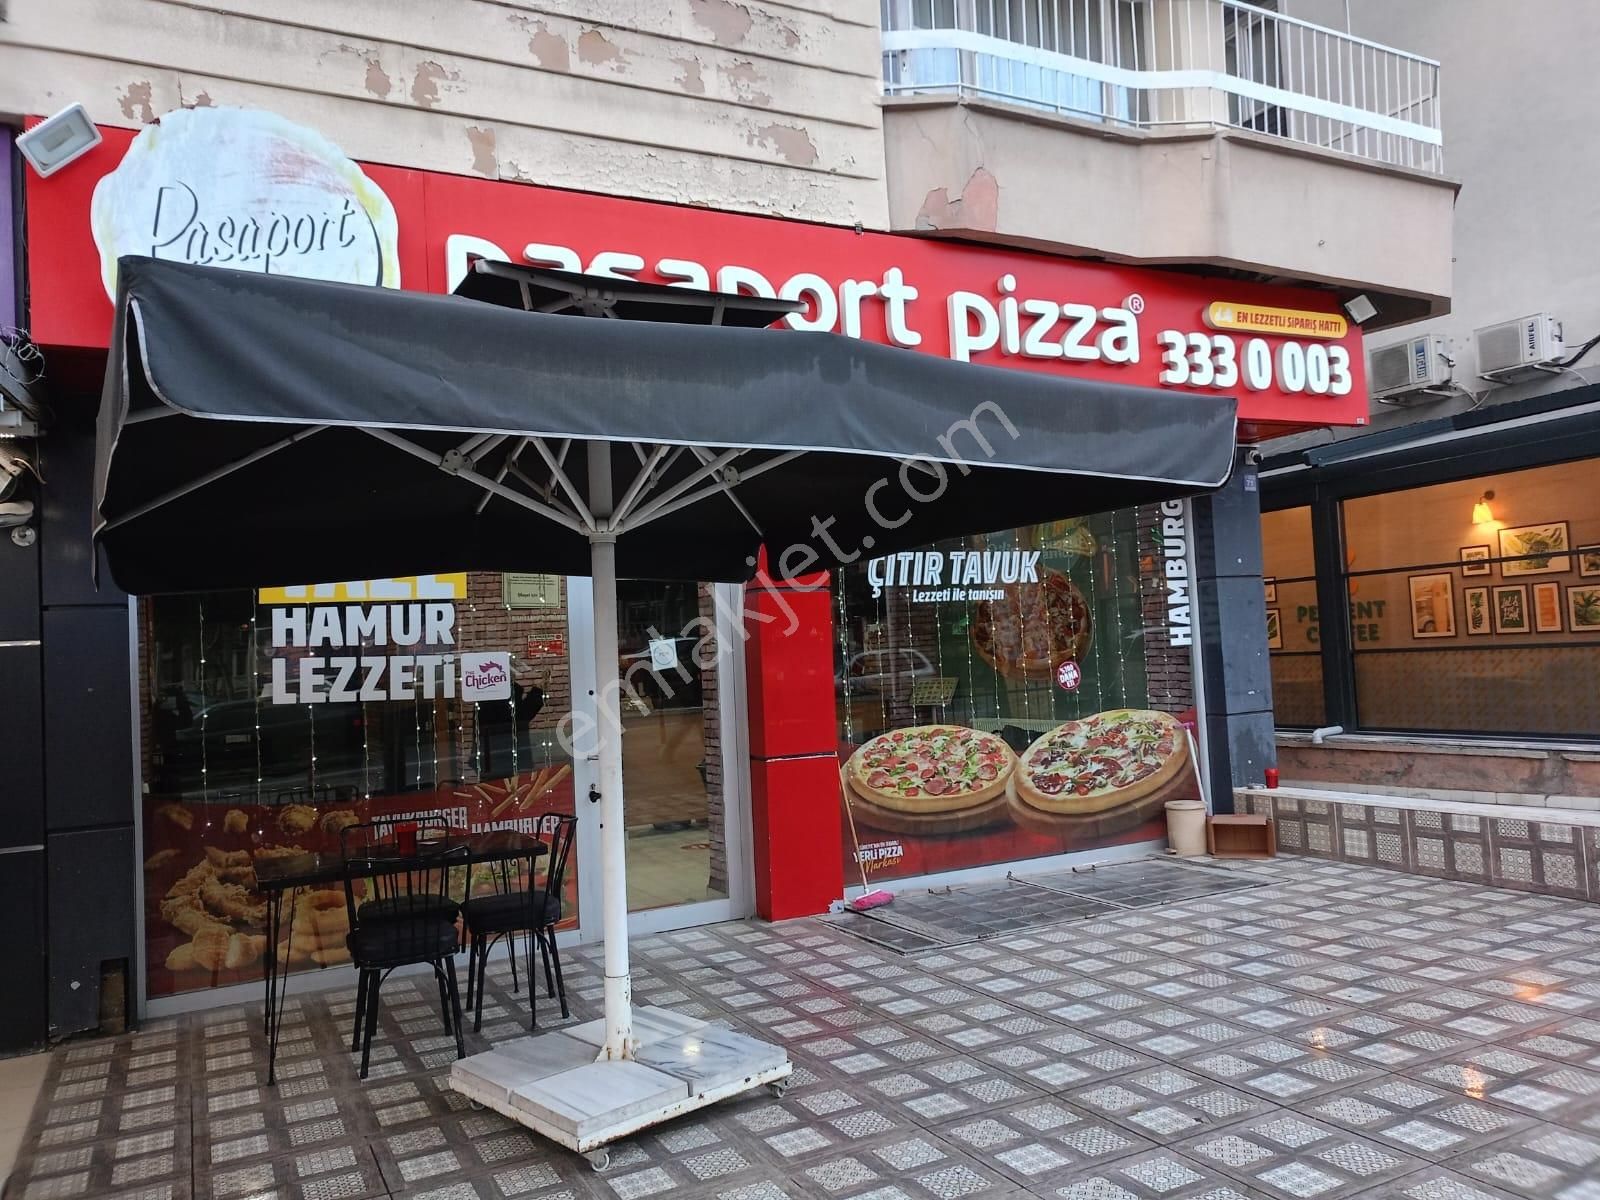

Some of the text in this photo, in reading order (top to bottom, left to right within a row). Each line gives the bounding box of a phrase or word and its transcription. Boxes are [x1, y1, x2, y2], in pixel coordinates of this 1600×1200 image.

[1236, 311, 1249, 323] EN
[1318, 319, 1341, 333] HATTI
[1158, 329, 1353, 396] 333 0 003
[867, 550, 1041, 599] ÇITIR TAVUK
[912, 588, 950, 603] Lezzeti
[953, 588, 966, 601] ile
[271, 602, 456, 648] HAMUR
[465, 673, 507, 690] Chicken
